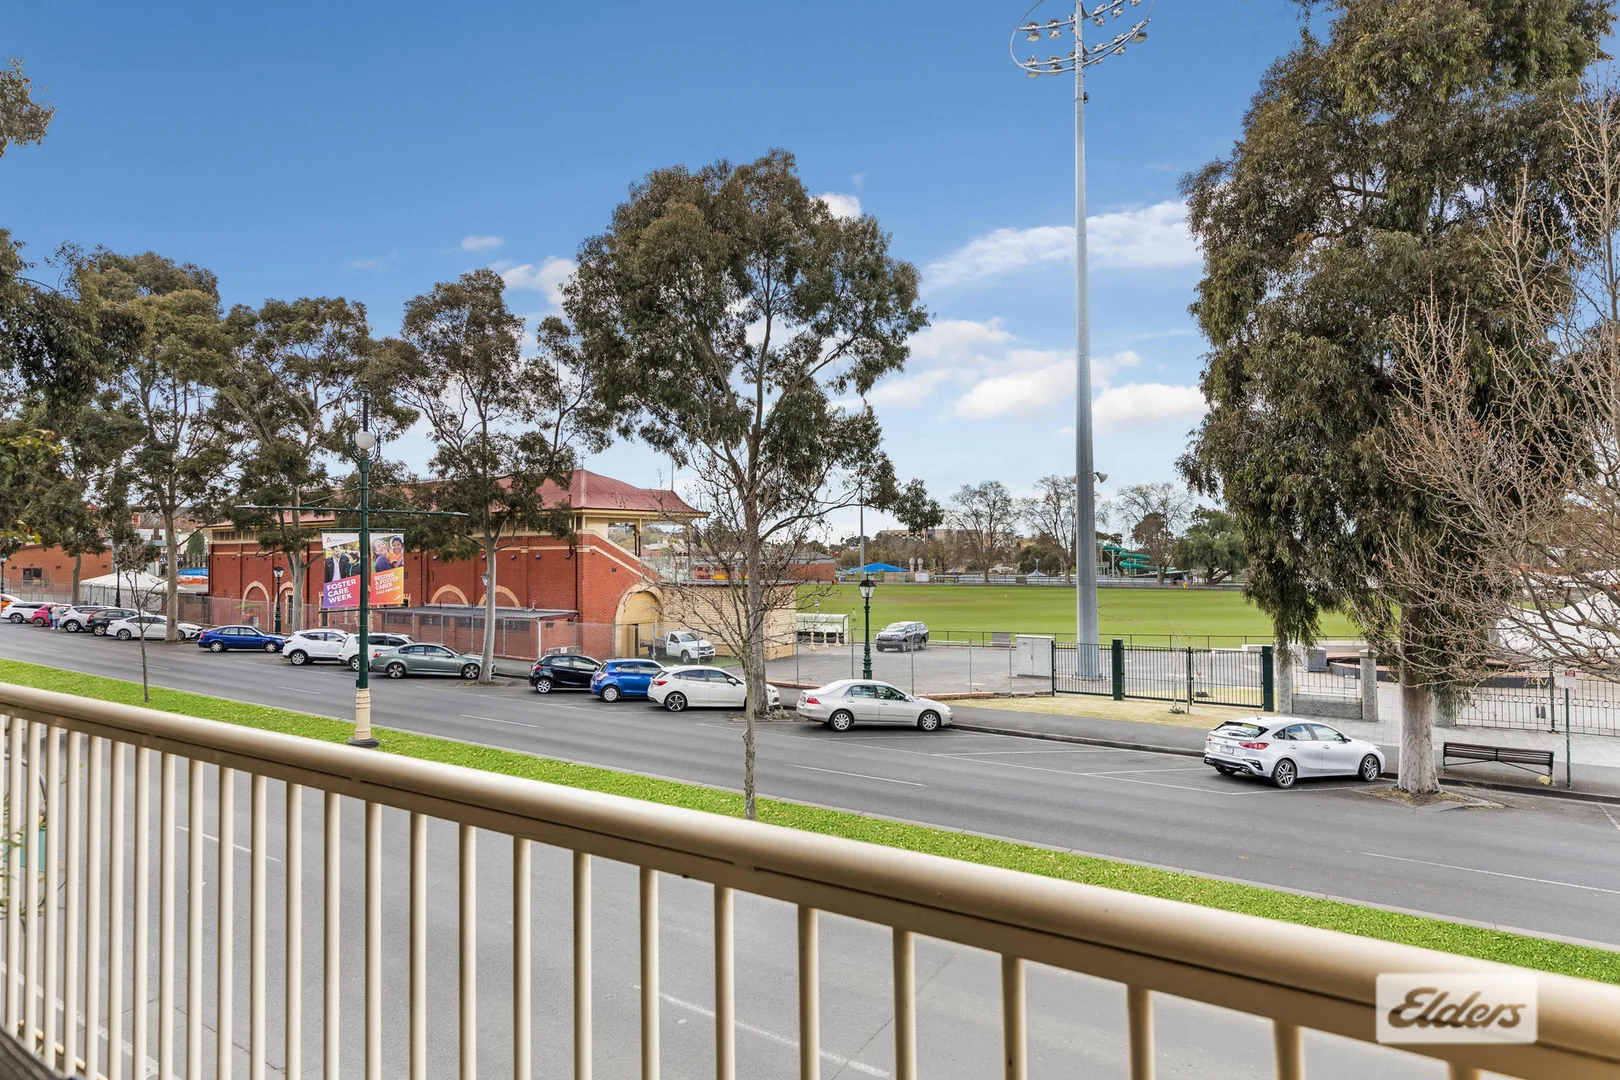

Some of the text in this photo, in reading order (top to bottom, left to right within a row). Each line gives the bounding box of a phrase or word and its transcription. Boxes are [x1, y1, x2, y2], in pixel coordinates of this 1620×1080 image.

[327, 579, 356, 591] FOSTER
[380, 576, 399, 585] FOSTER
[328, 587, 349, 597] CARE
[328, 593, 352, 603] WEEK
